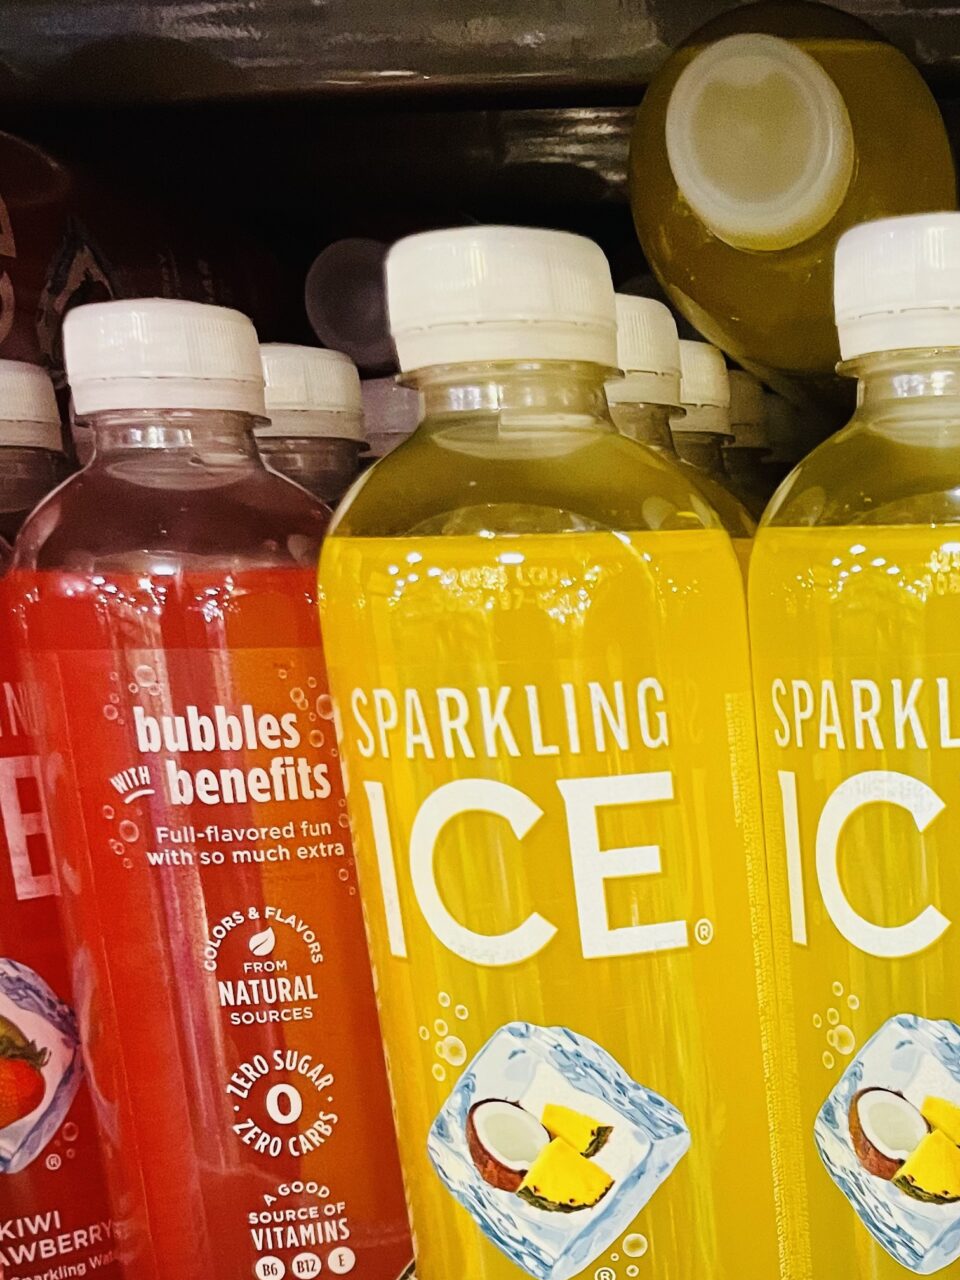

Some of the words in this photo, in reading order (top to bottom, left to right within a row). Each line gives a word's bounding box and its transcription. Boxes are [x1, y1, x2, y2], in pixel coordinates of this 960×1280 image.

[134, 705, 300, 752] bubbles
[352, 677, 669, 759] SPARKLING
[109, 765, 151, 795] WITH
[166, 757, 332, 804] benefits
[157, 822, 295, 844] Full-flavored
[301, 821, 331, 837] fun
[147, 850, 193, 867] with
[200, 851, 225, 866] so
[232, 846, 291, 864] much
[297, 842, 345, 858] extra
[363, 771, 689, 966] ICE
[203, 910, 246, 972] COLORS
[248, 907, 261, 920] &
[265, 906, 324, 964] FLAVORS
[243, 960, 288, 973] FROM
[218, 975, 319, 1006] NATURAL
[230, 1007, 313, 1026] SOURCES
[226, 1054, 270, 1098] ZERO
[273, 1049, 334, 1091] SUGAR
[266, 1083, 303, 1125] 0
[233, 1117, 283, 1157] ZERO
[288, 1111, 339, 1157] CARBS
[263, 1193, 278, 1206] A
[278, 1180, 331, 1198] GOOD
[248, 1206, 319, 1225] SOURCE
[323, 1201, 347, 1217] OF
[250, 1218, 351, 1251] VITAMINS
[262, 1263, 279, 1277] B6
[296, 1259, 317, 1274] B12
